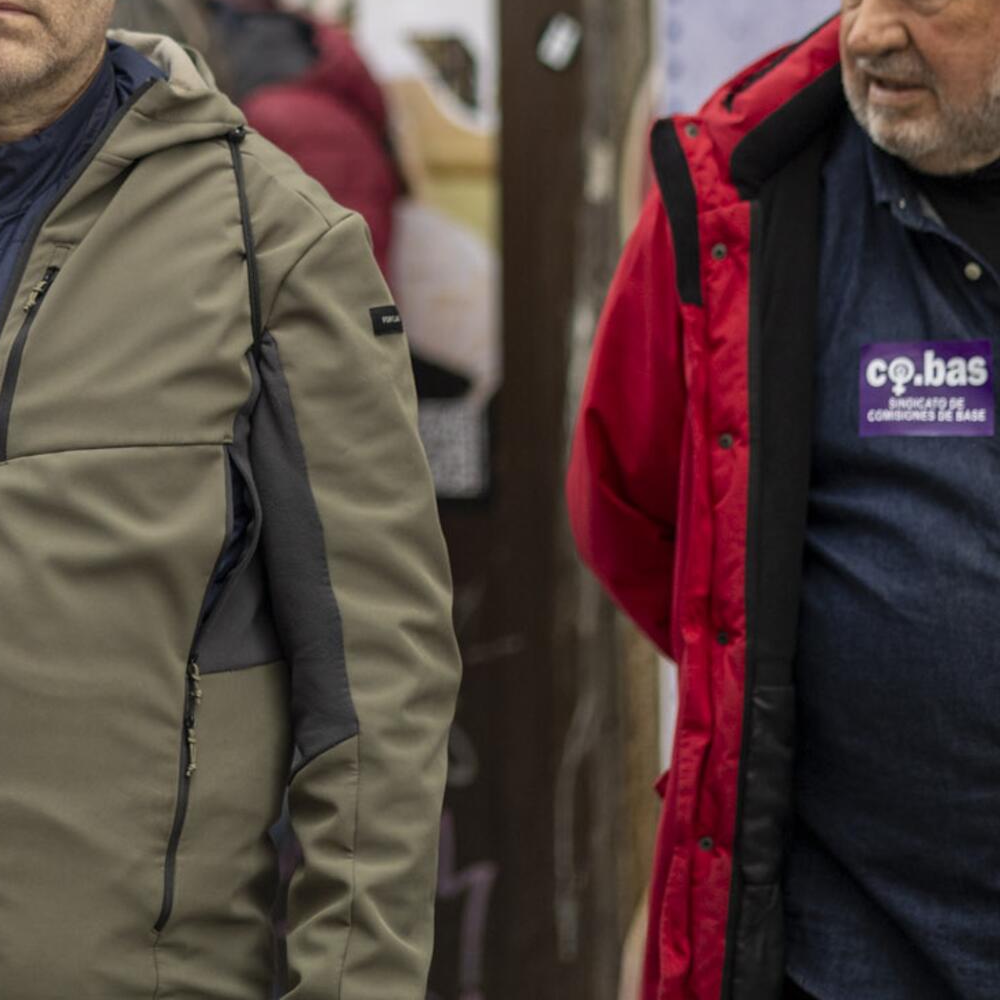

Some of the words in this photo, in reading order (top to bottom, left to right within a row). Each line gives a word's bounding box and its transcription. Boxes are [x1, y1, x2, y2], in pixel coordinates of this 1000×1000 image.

[887, 396, 948, 410] SINDICATO
[949, 396, 966, 410] DE
[866, 408, 935, 423] COMISIONES
[937, 409, 953, 422] DE
[955, 408, 987, 422] BASE
